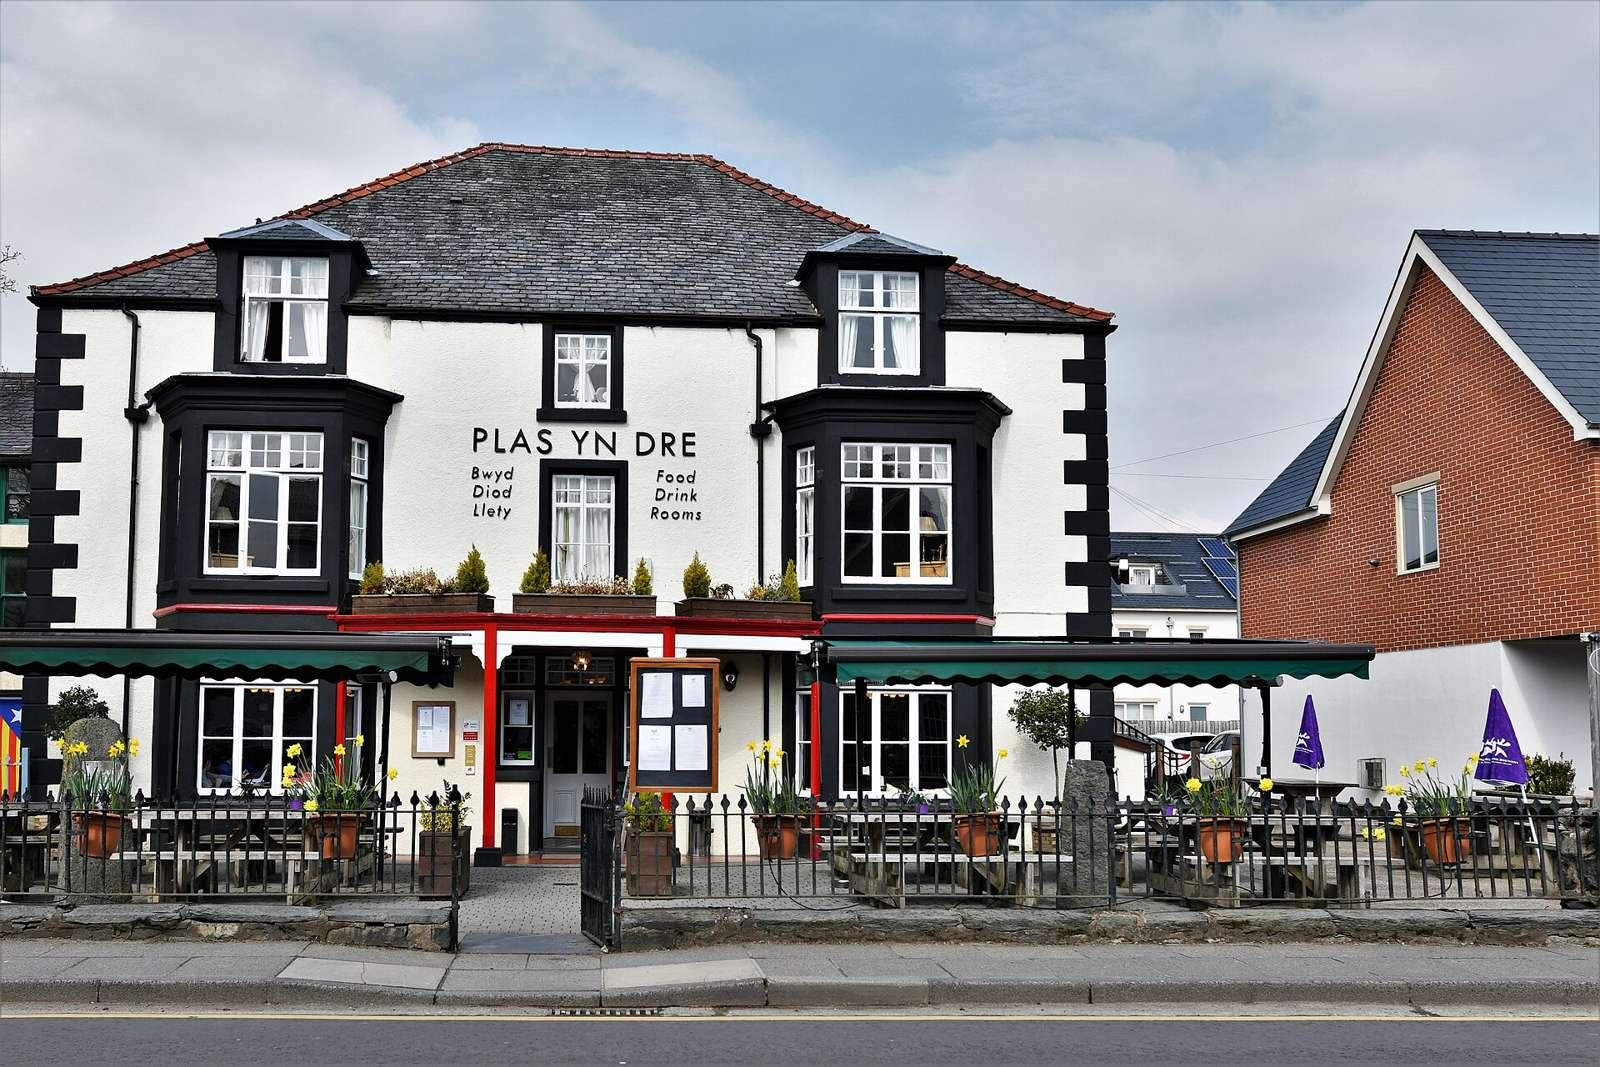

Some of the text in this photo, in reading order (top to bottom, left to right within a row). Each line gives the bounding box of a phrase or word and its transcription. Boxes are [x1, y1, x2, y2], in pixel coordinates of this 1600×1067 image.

[472, 427, 696, 458] PLAS YN DRE
[471, 466, 514, 481] Bwyd
[656, 469, 697, 484] Food
[472, 484, 513, 499] Diod
[654, 487, 698, 503] Drink
[473, 503, 512, 520] Llety
[650, 506, 702, 521] Rooms
